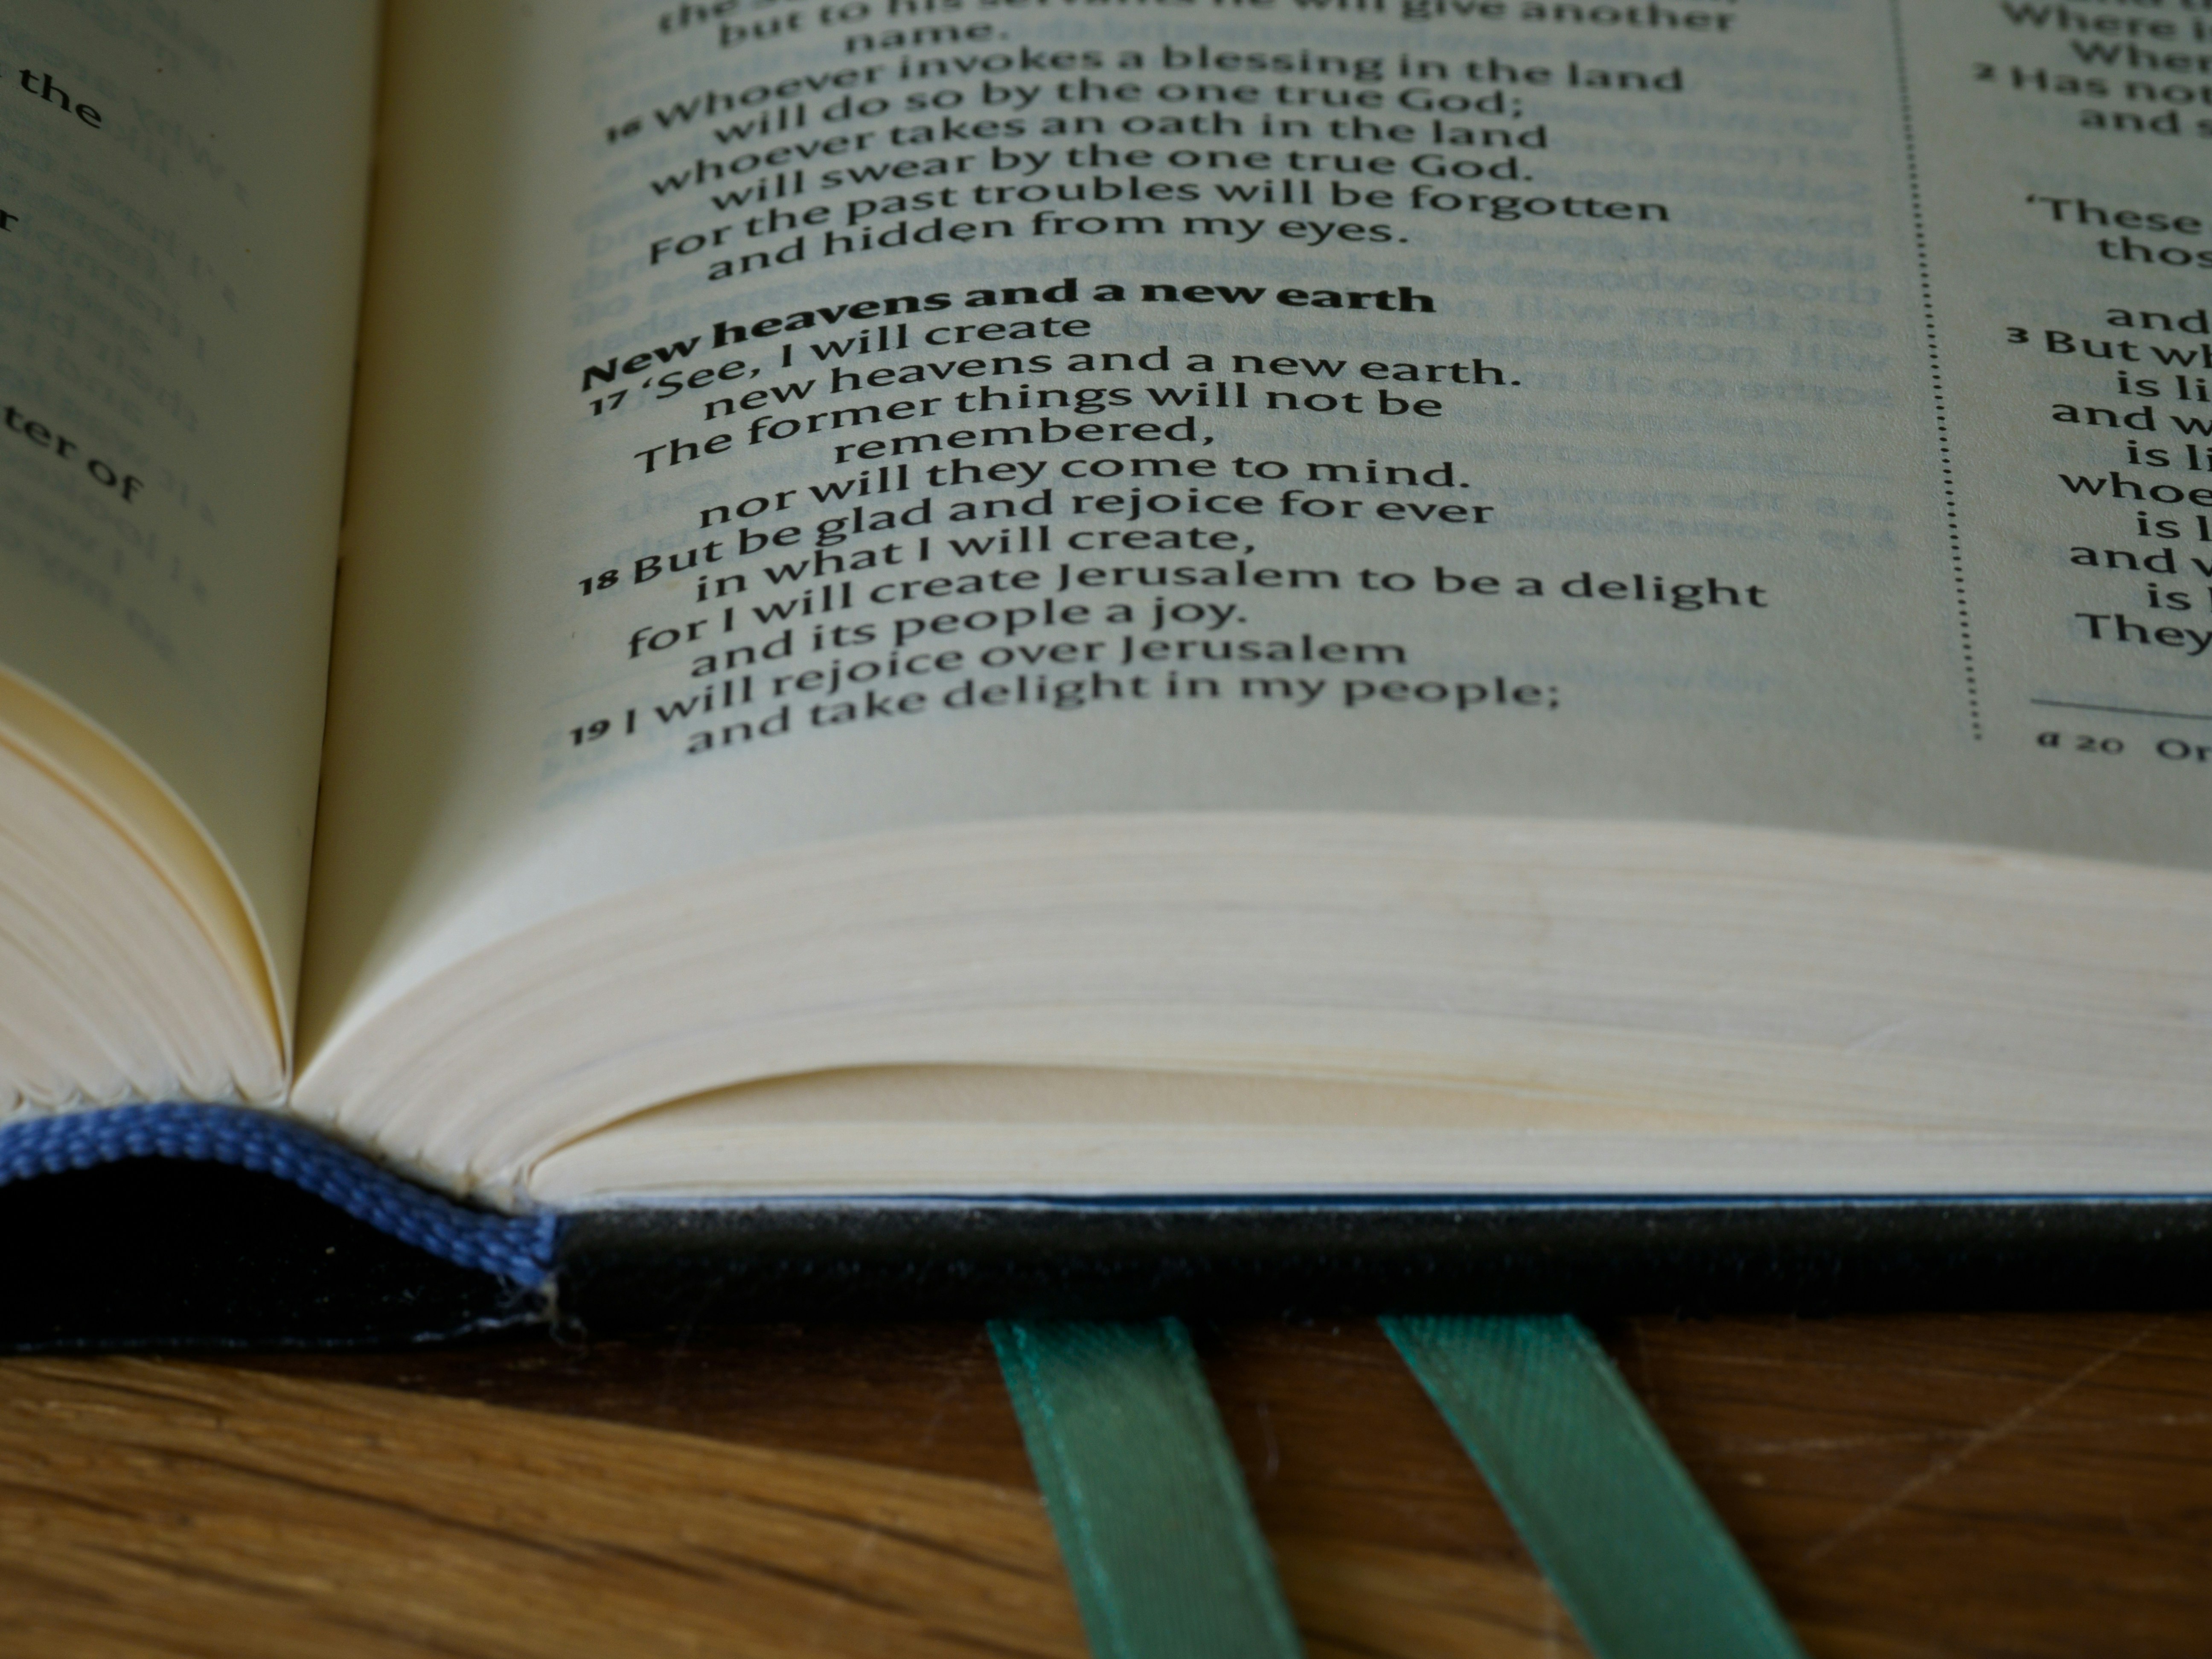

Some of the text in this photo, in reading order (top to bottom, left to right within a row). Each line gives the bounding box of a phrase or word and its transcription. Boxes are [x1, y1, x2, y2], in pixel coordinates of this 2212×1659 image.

[719, 12, 801, 49] but
[819, 2, 871, 26] to
[1520, 2, 1734, 32] another
[844, 22, 1010, 56] name.
[2000, 0, 2177, 40] Where
[18, 68, 103, 130] the
[653, 66, 879, 130] Whoever
[898, 45, 1104, 81] invokes
[1118, 51, 1145, 70] a
[1162, 44, 1384, 83] blessing
[1399, 53, 1449, 81] in
[1465, 56, 1552, 86] the
[1568, 61, 1684, 93] land
[713, 76, 1523, 146] will do so by the one true God;
[2010, 66, 2109, 98] Has
[649, 110, 1548, 197] whoever takes an oath in the land
[2079, 109, 2182, 137] and
[710, 141, 1534, 212] will swear by the one true God.
[649, 224, 733, 267] For
[745, 205, 831, 238] the
[846, 186, 958, 227] past
[972, 174, 1201, 206] troubles
[1214, 178, 1313, 206] will
[1330, 180, 1394, 210] be
[1409, 184, 1671, 223] forgotten
[707, 210, 1409, 282] and hidden from my eyes.
[580, 276, 1438, 393] New heavens and a new earth
[2006, 326, 2030, 345] 3
[2044, 329, 2141, 363] But
[2105, 308, 2211, 336] and
[589, 388, 629, 417] 17
[780, 343, 793, 369] I
[809, 322, 909, 362] will
[924, 316, 1092, 346] create
[704, 378, 817, 422] new
[830, 354, 1053, 395] heavens
[1067, 344, 1170, 373] and
[1185, 353, 1215, 373] a
[1231, 354, 1348, 379] new
[1359, 358, 1522, 387] earth.
[2116, 370, 2161, 398] is
[633, 381, 1443, 474] The former things will not be
[833, 415, 1214, 465] remembered,
[2052, 403, 2157, 433] and
[86, 458, 144, 504] of
[2126, 439, 2171, 468] is
[699, 456, 1470, 530] nor will they come to mind.
[578, 568, 620, 597] 18
[633, 540, 723, 585] But
[738, 526, 802, 556] be
[814, 496, 933, 548] glad
[948, 487, 1054, 523] and
[1071, 486, 1264, 522] rejoice
[1279, 488, 1364, 520] for
[1375, 501, 1495, 525] ever
[2136, 510, 2181, 540] is
[696, 524, 1255, 603] in what I will create,
[2069, 546, 2178, 575] and
[628, 559, 1768, 660] for I will create Jerusalem to be a delight
[2146, 582, 2193, 612] is
[690, 596, 1247, 678] and its people a joy.
[2074, 611, 2212, 657] They
[570, 633, 1407, 747] 19 I will rejoice over Jerusalem
[686, 670, 1560, 755] and take delight in my people;
[2035, 731, 2061, 749] a
[2075, 735, 2125, 755] 20
